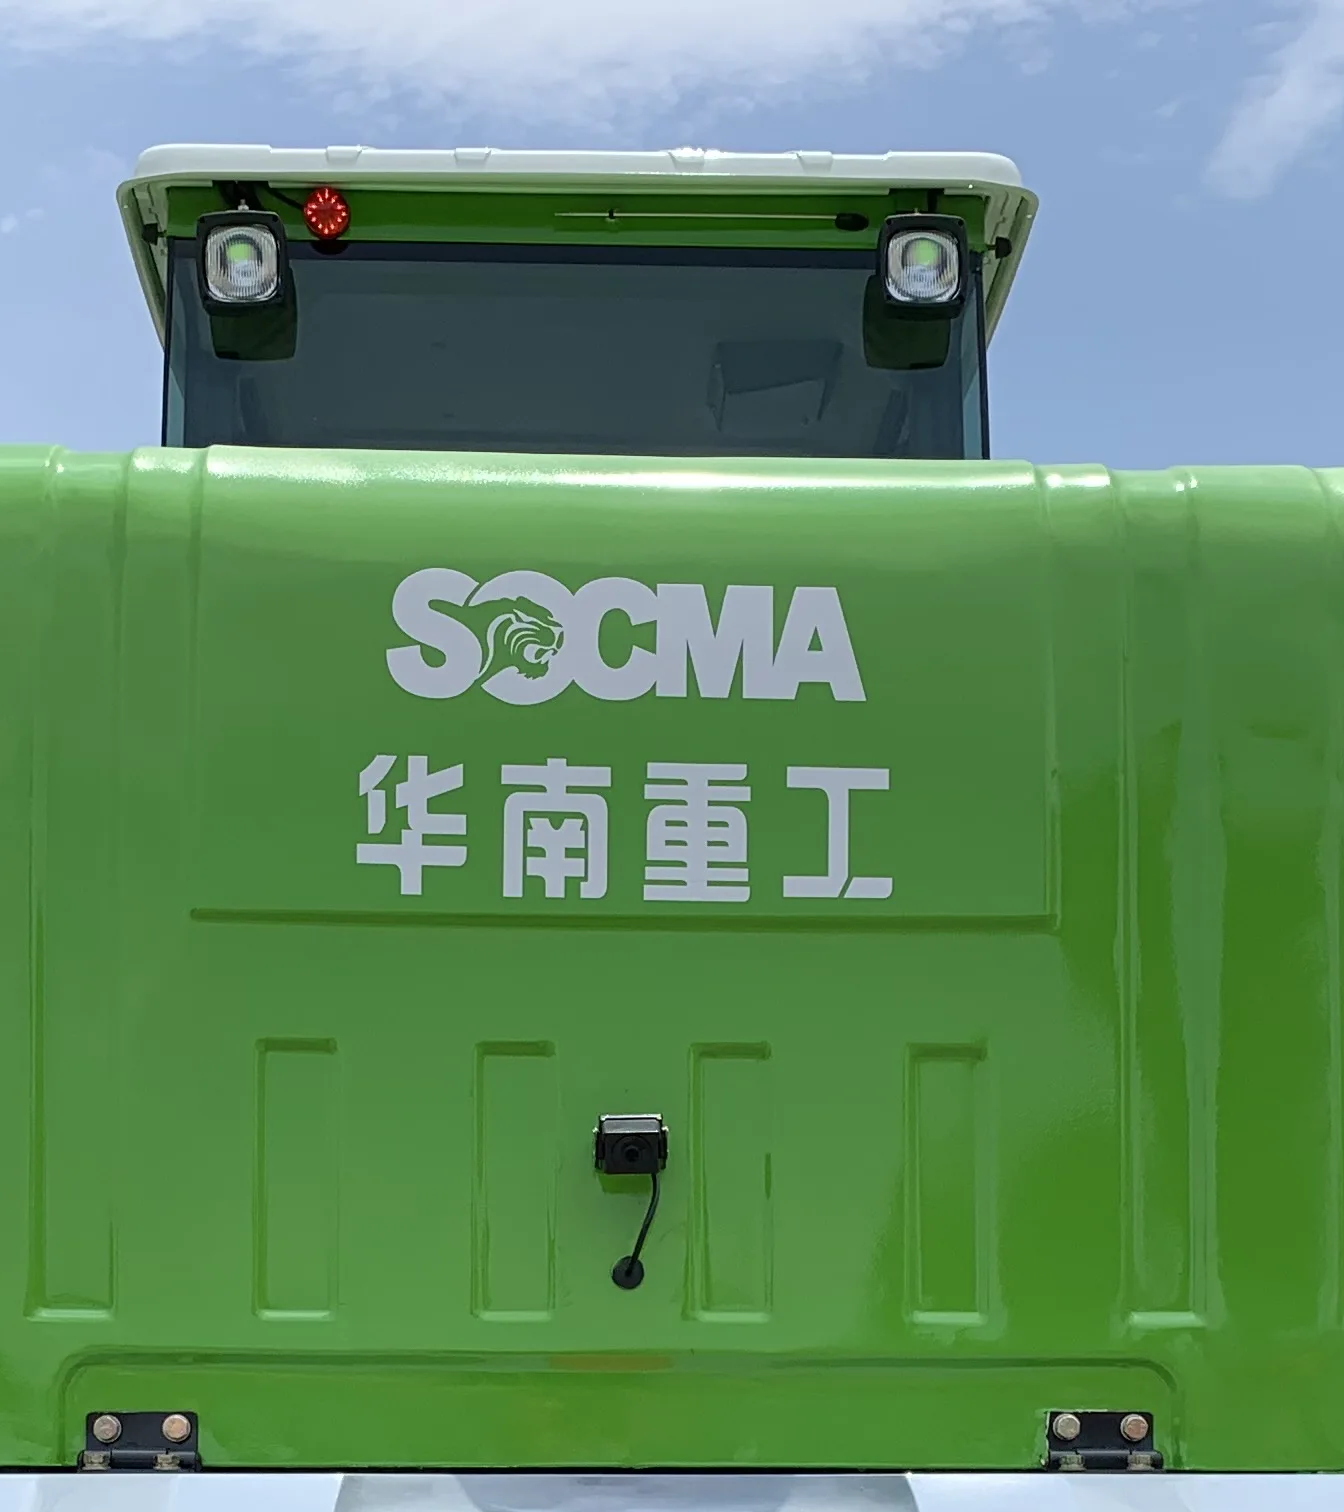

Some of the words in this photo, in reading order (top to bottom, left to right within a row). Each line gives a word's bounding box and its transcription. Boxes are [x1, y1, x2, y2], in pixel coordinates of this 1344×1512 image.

[386, 567, 866, 706] SOCMA
[356, 754, 893, 903] 华南重工
